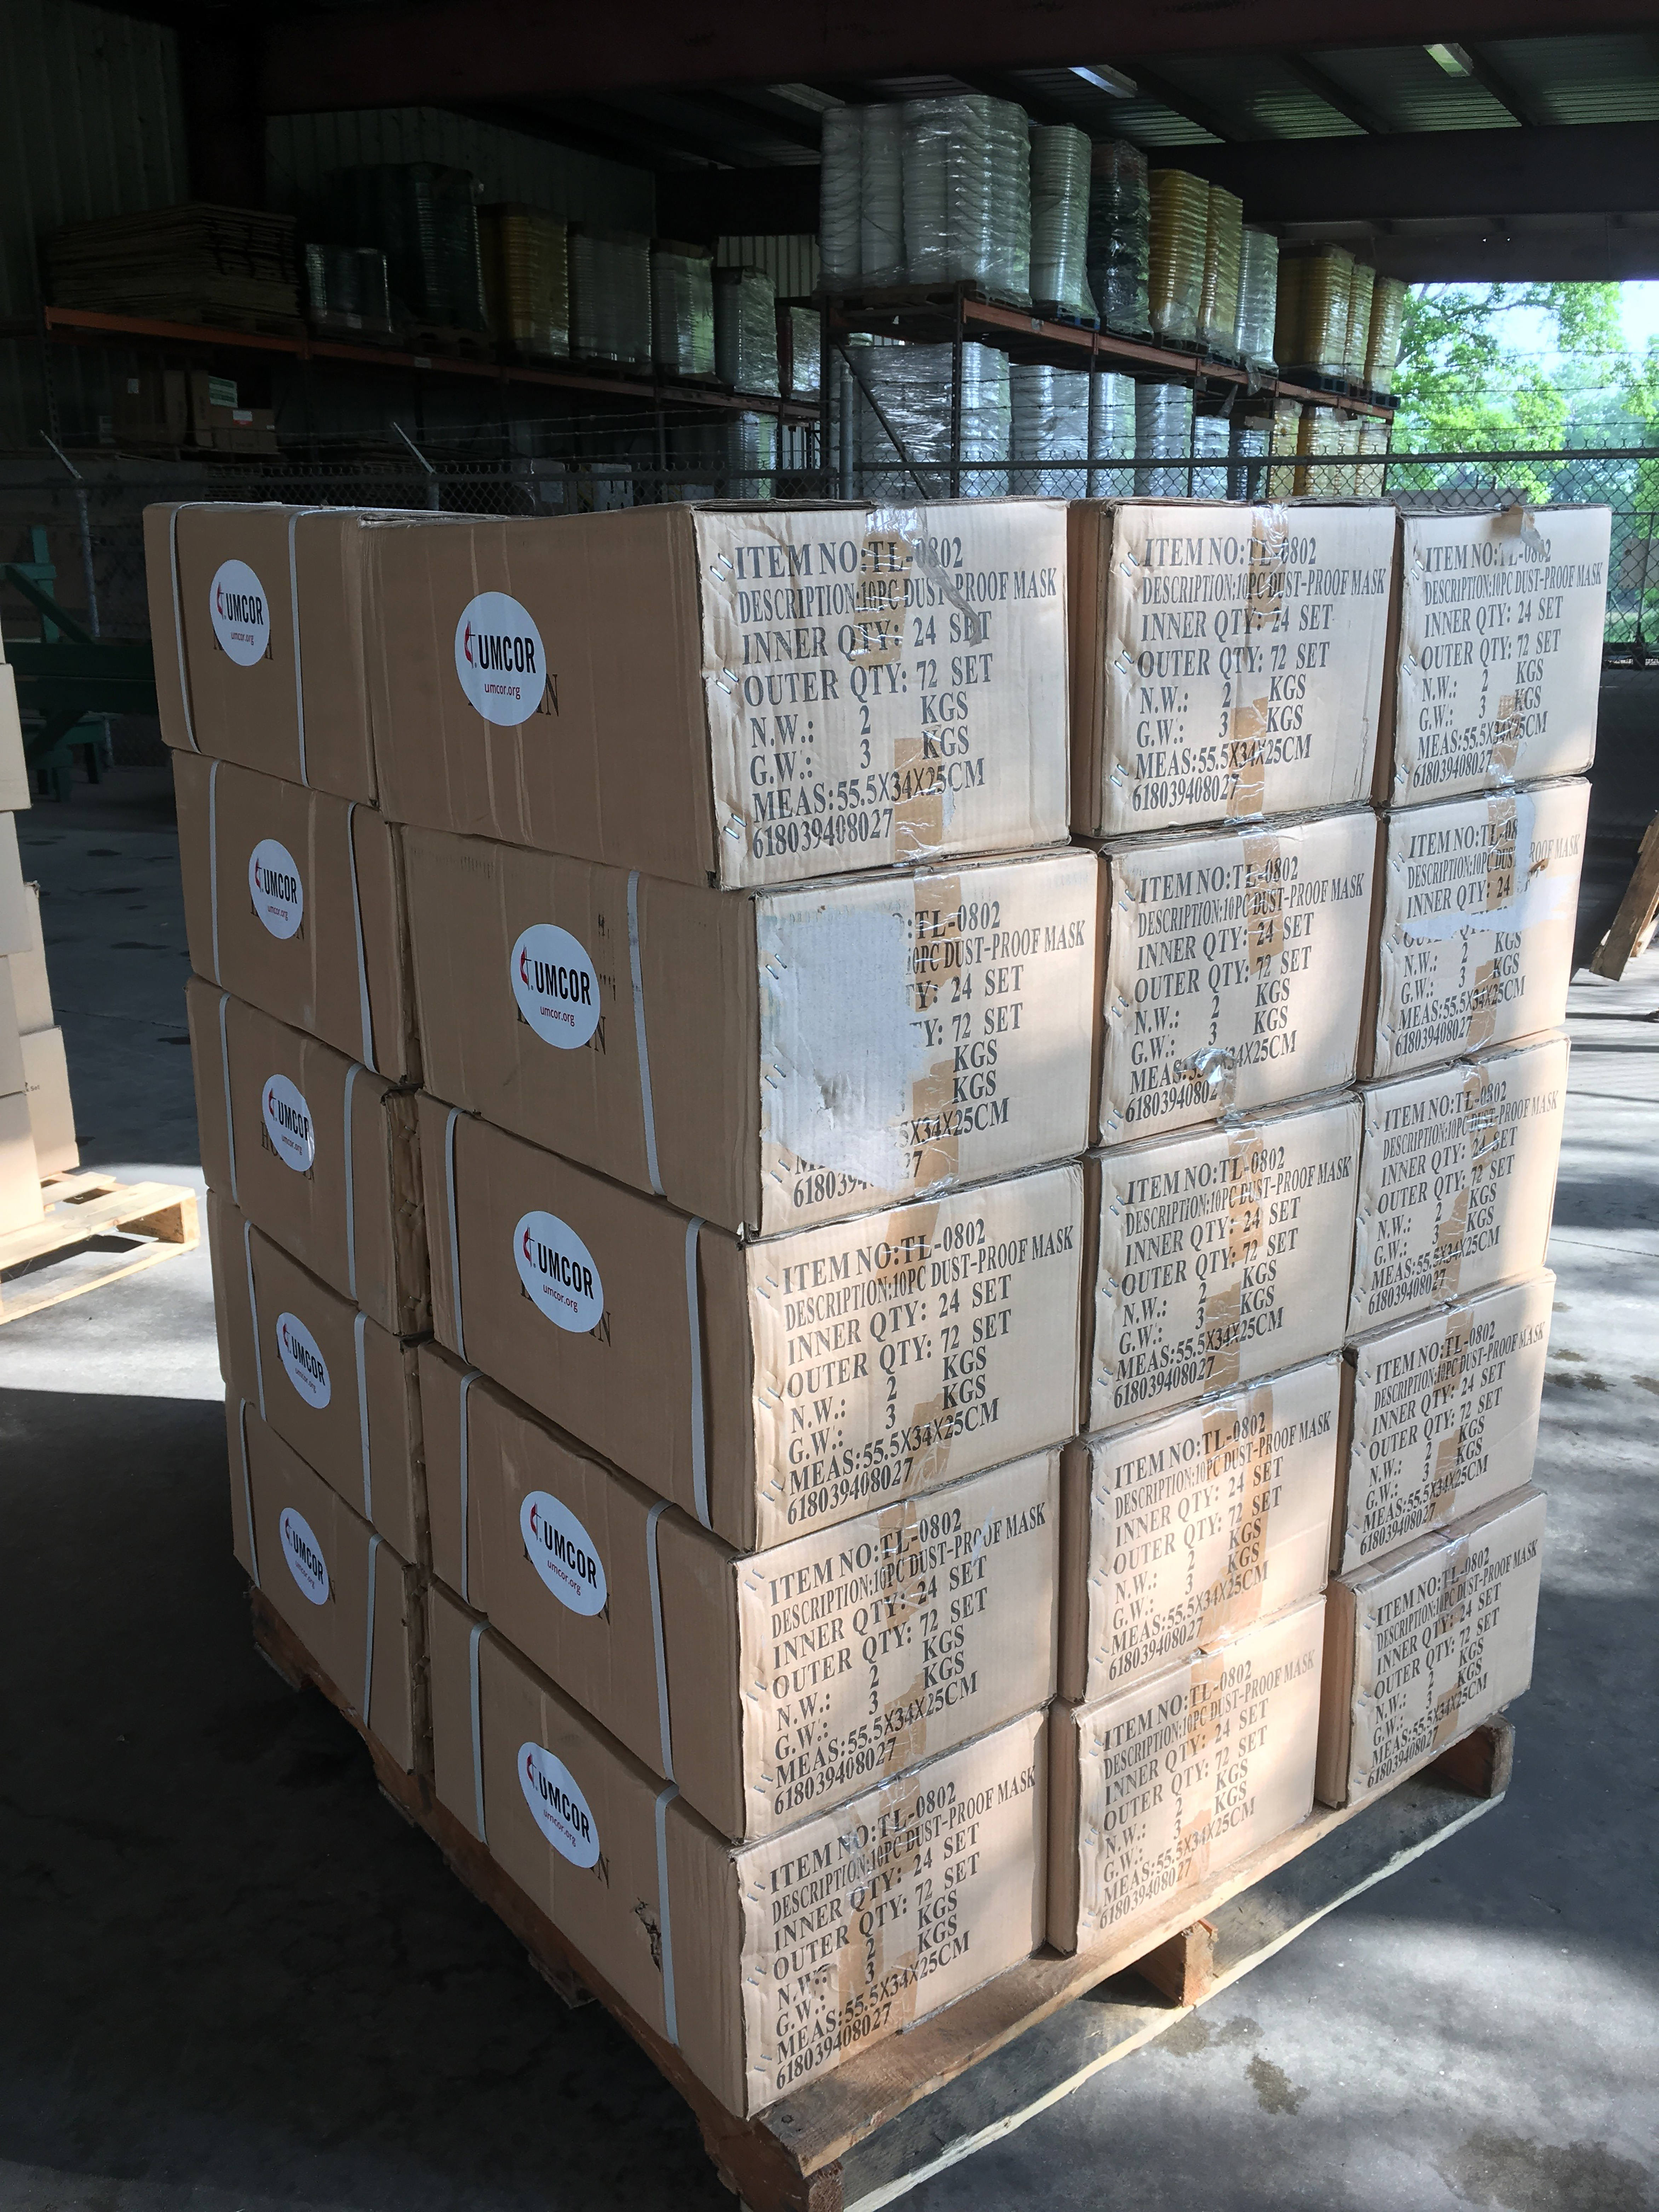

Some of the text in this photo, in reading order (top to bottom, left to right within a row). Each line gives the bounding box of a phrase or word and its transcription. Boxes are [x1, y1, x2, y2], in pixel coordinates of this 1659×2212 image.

[1515, 564, 1575, 594] DUST-PROOF
[1576, 562, 1603, 588] MASK
[226, 593, 264, 625] UMCOR
[1425, 595, 1563, 638] INNER QTY: 24 SET
[478, 635, 536, 673] UMCOR
[1141, 641, 1330, 680] OUTER QTY: 72 SET
[1422, 628, 1561, 671] OUTER QTY: 72 SET
[484, 683, 521, 700] umcor.org
[745, 653, 995, 709] OUTER QTY: 72 SET
[1222, 681, 1231, 708] 2
[1268, 674, 1307, 703] KGS
[859, 704, 871, 735] 2
[918, 690, 970, 726] KGS
[753, 805, 895, 860] 618039408027
[264, 869, 298, 904] UMCOR
[1140, 871, 1192, 904] ITEM
[1407, 886, 1452, 919] INNER
[1456, 878, 1491, 913] QTY:
[1497, 874, 1510, 899] 24
[943, 927, 1040, 969] DUST-PROOF
[1044, 920, 1085, 952] MASK
[1137, 912, 1314, 971] INNER QTY: 24 SET
[1461, 941, 1468, 964] 2
[1494, 927, 1522, 954] KGS
[534, 961, 591, 1005] UMCOR
[951, 973, 971, 1003] 24
[985, 964, 1024, 997] SET
[1458, 966, 1465, 989] 3
[1492, 952, 1520, 980] KGS
[540, 1006, 575, 1027] umcor.org
[952, 1013, 971, 1042] 72
[984, 1002, 1023, 1036] SET
[1211, 994, 1220, 1019] 2
[1255, 977, 1291, 1008] KGS
[953, 1039, 997, 1073] KGS
[1396, 1013, 1473, 1058] 618039408027
[952, 1069, 996, 1104] KGS
[1378, 1154, 1515, 1216] OUTER QTY: 72 SET
[1435, 1201, 1442, 1222] 2
[1468, 1181, 1497, 1210] KGS
[1126, 1196, 1301, 1267] INNER QTY: 24 SET
[538, 1243, 594, 1299] UMCOR
[783, 1251, 850, 1295] ITEM
[931, 1237, 1028, 1288] DUST-PROOF
[1031, 1225, 1074, 1261] MASK
[543, 1284, 578, 1313] umcor.org
[788, 1273, 1012, 1366] INNER QTY: 24 SET
[1195, 1307, 1204, 1331] 3
[1239, 1284, 1275, 1316] KGS
[292, 1336, 325, 1386] UMCOR
[788, 1308, 1012, 1401] OUTER QTY: 72 SET
[1115, 1353, 1216, 1409] 618039408027
[1372, 1360, 1505, 1437] INNER QTY: 24 SET
[1223, 1423, 1297, 1474] DUST-PROOF
[1299, 1410, 1331, 1443] MASK
[1425, 1440, 1432, 1461] 2
[1457, 1414, 1485, 1444] KGS
[788, 1454, 914, 1526] 618039408027
[544, 1520, 597, 1589] UMCOR
[1114, 1484, 1282, 1577] OUTER QTY: 72 SET
[293, 1530, 323, 1585] UMCOR
[547, 1560, 581, 1596] umcor.org
[775, 1554, 988, 1670] INNER QTY: 24 SET
[774, 1586, 988, 1702] OUTER QTY: 72 SET
[1375, 1606, 1499, 1702] OUTER QTY: 72 SET
[868, 1690, 878, 1717] 3
[922, 1649, 965, 1691] KGS
[1425, 1690, 1432, 1711] 3
[1457, 1656, 1482, 1689] KGS
[1106, 1697, 1268, 1807] INNER QTY: 24 SET
[1369, 1723, 1439, 1790] 618039408027
[539, 1771, 591, 1843] UMCOR
[1175, 1795, 1182, 1818] 2
[1215, 1756, 1248, 1794] KGS
[544, 1809, 576, 1847] umcor.org
[774, 1821, 981, 1954] INNER QTY: 24 SET
[774, 1851, 981, 1984] OUTER QTY: 72 SET
[776, 1999, 892, 2090] 618039408027
